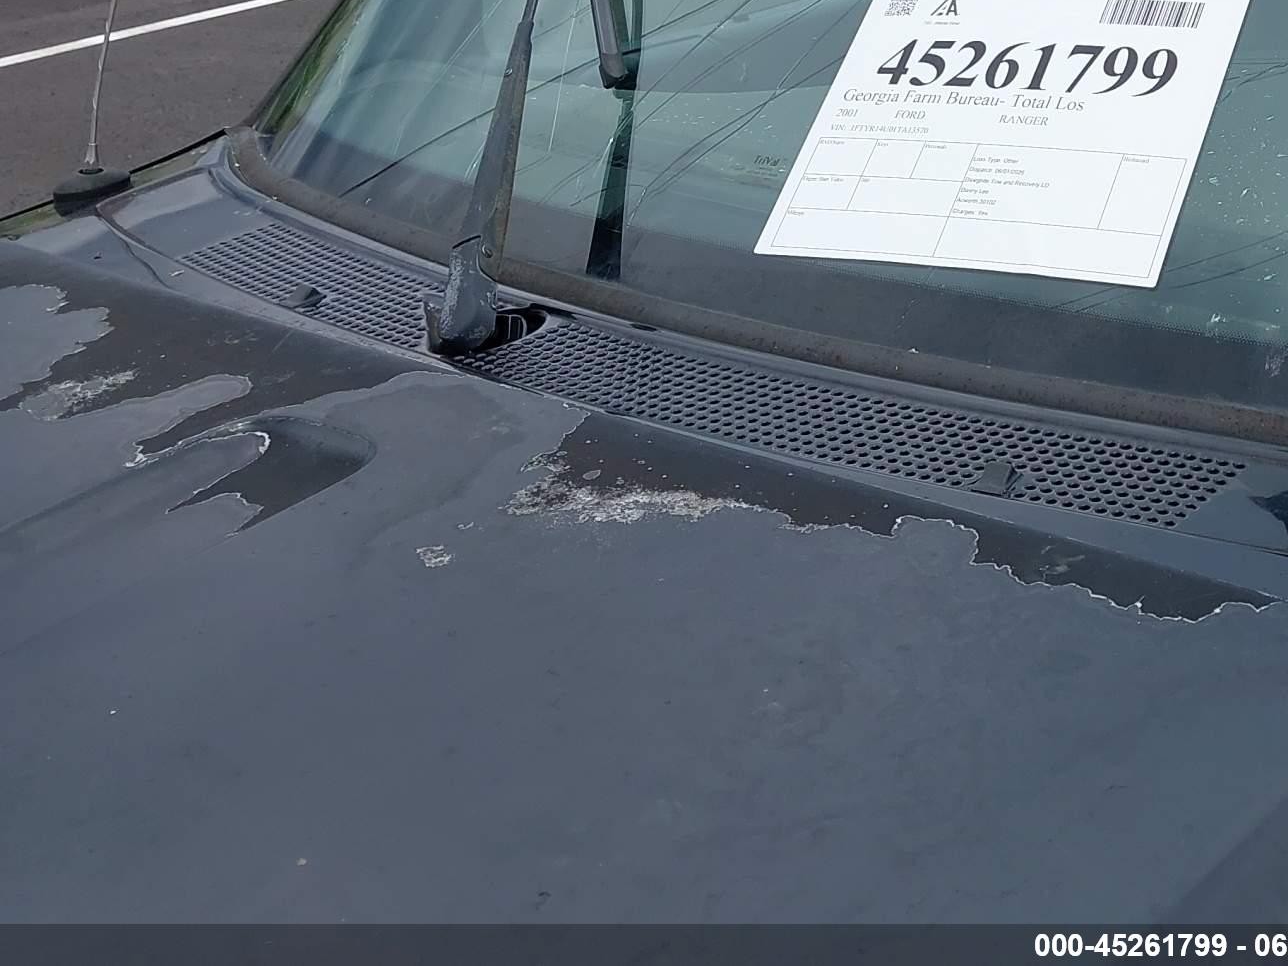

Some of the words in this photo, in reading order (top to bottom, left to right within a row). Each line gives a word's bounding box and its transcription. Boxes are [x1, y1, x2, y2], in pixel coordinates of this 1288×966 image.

[876, 38, 1179, 97] 45261799
[843, 88, 899, 105] Georgia
[904, 90, 942, 104] Farm
[946, 91, 1006, 107] Bureau-
[1011, 94, 1052, 110] Total
[1055, 96, 1085, 111] Los
[835, 108, 858, 117] 2001
[894, 110, 926, 120] FORD
[999, 115, 1049, 126] RANGER
